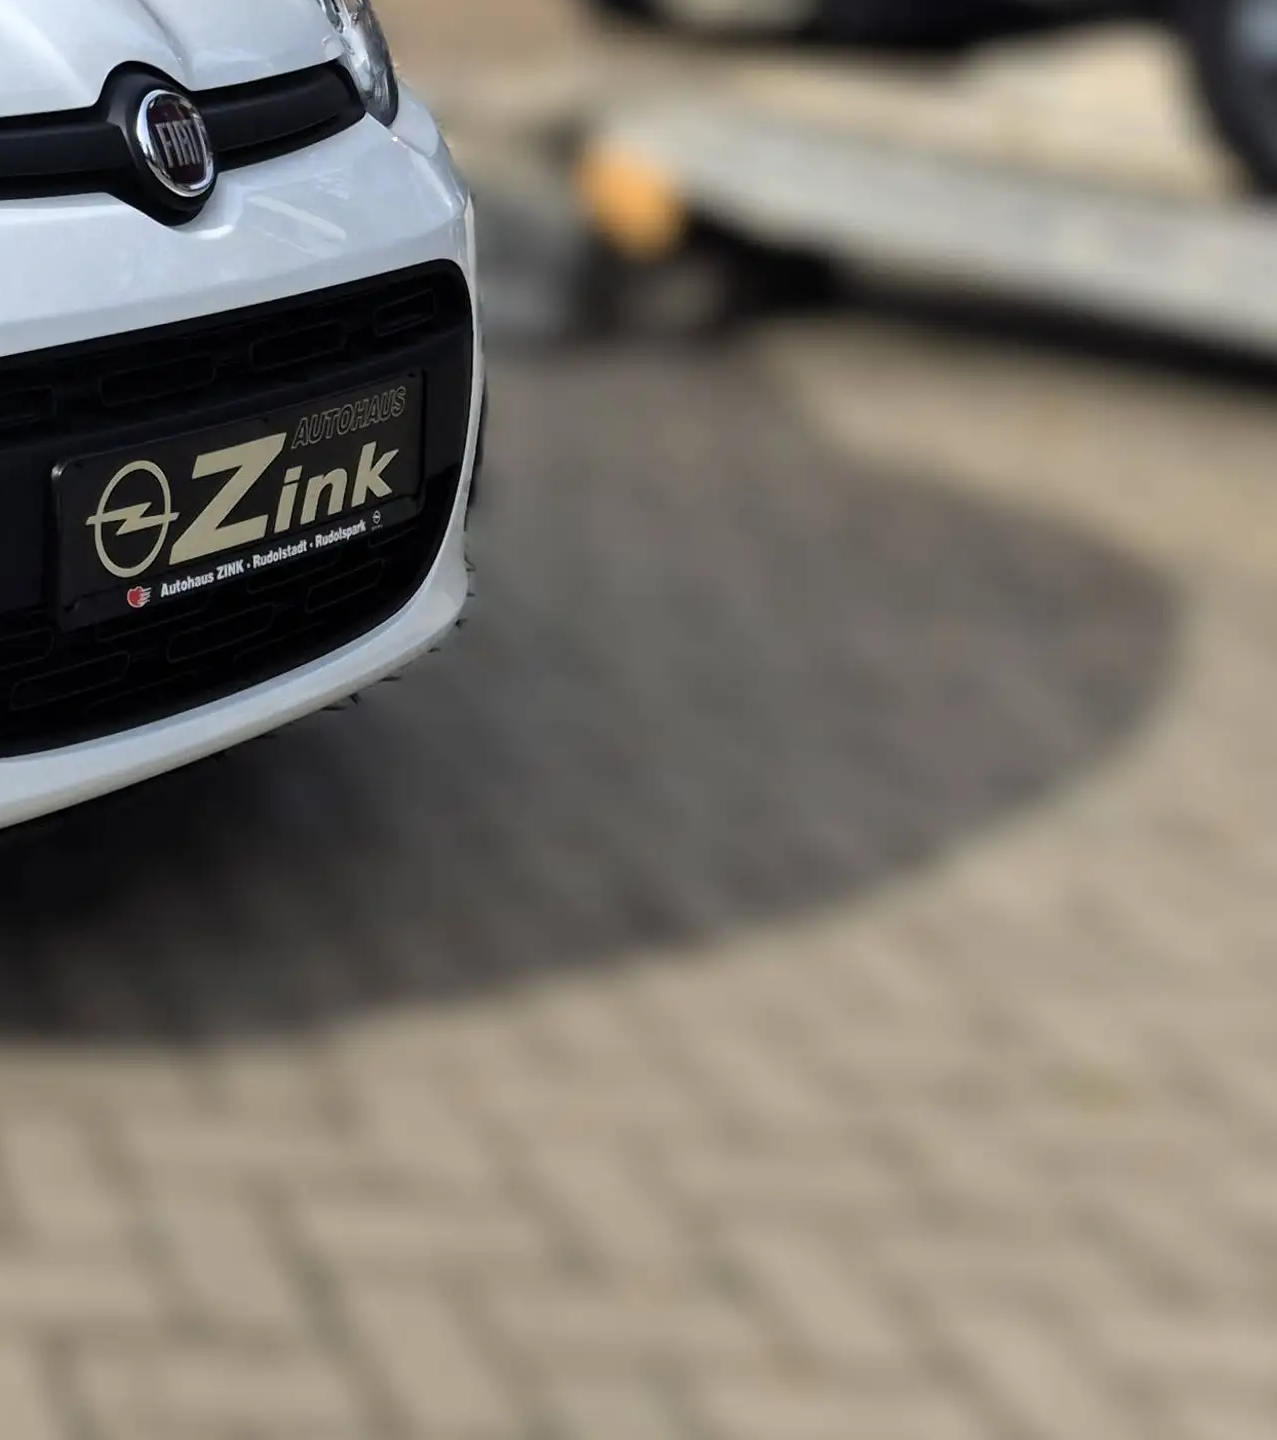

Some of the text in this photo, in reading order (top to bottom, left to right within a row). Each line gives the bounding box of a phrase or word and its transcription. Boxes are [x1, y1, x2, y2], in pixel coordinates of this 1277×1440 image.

[155, 118, 204, 167] FIAT
[292, 386, 406, 449] AUTOHAUS
[169, 432, 400, 565] Zink
[160, 519, 366, 598] Autohaus ZINK Rudolstadt Rudolspark
